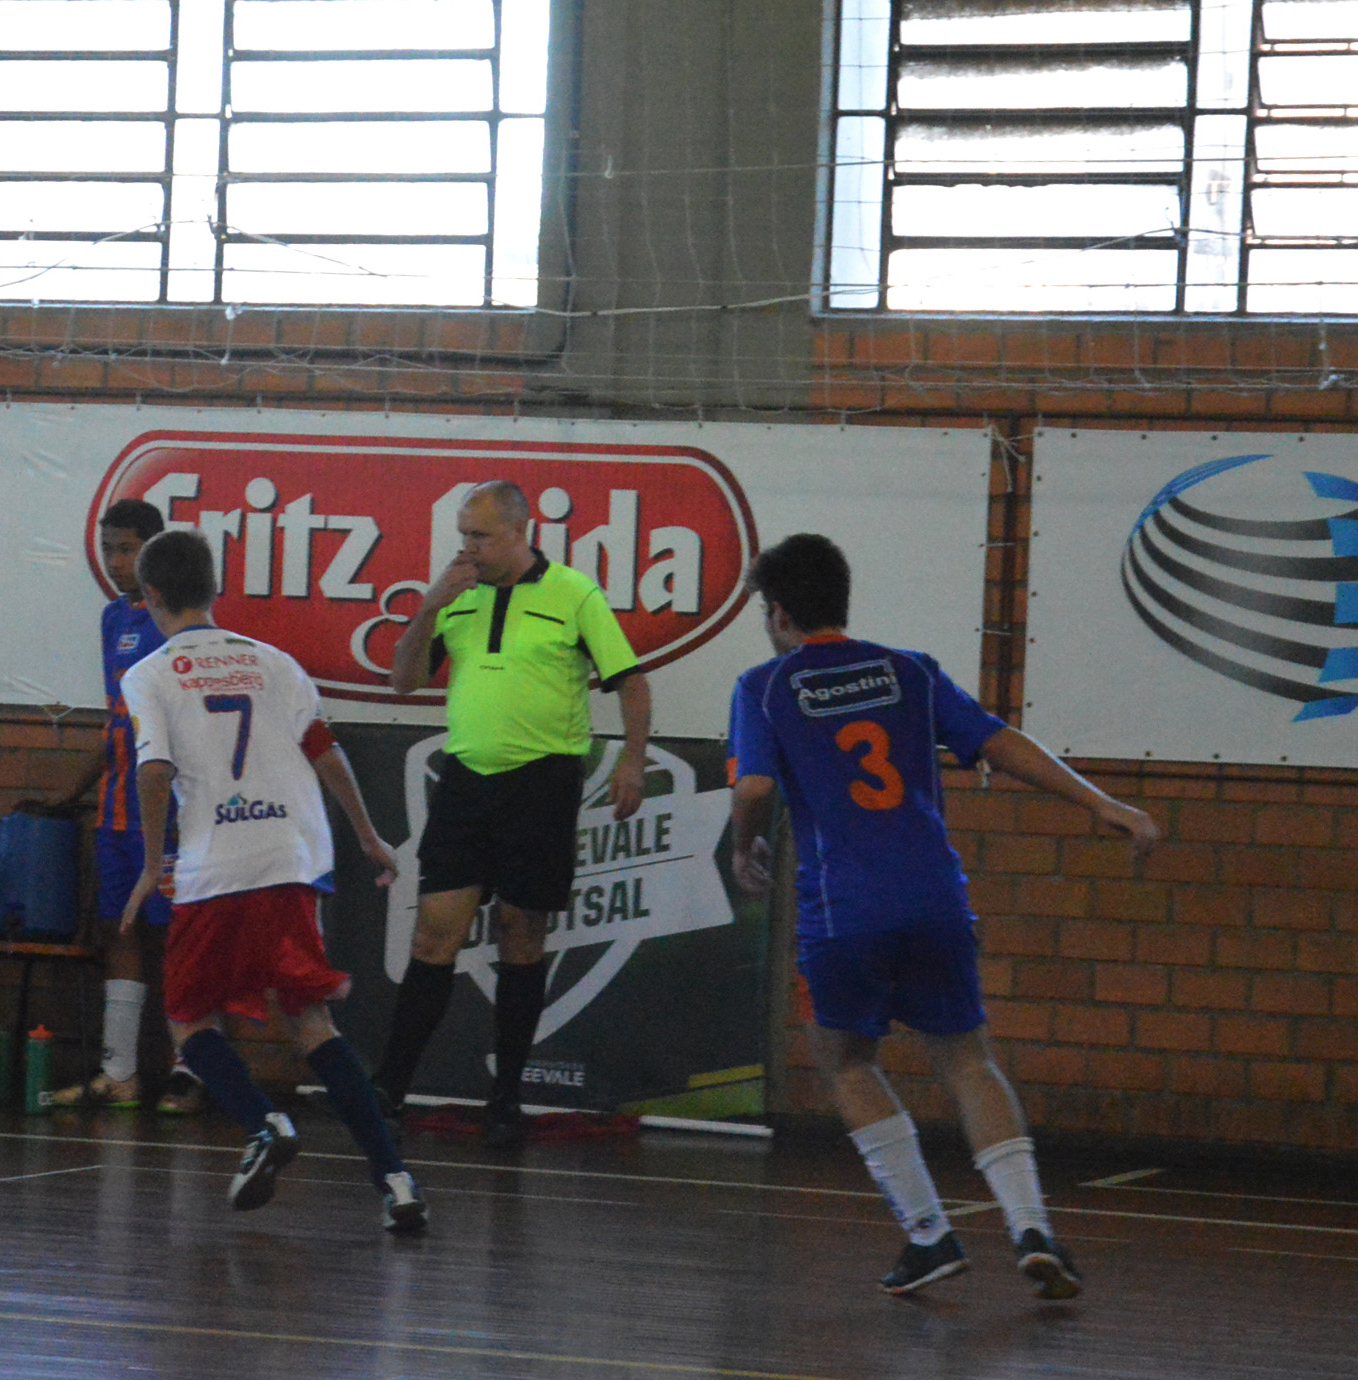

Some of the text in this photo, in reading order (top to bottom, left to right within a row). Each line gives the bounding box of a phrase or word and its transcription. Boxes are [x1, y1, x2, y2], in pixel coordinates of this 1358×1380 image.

[430, 482, 702, 613] ida
[204, 694, 252, 780] 7
[835, 720, 904, 811] 3
[576, 812, 672, 868] EVALE
[521, 1067, 585, 1087] EEVALE
